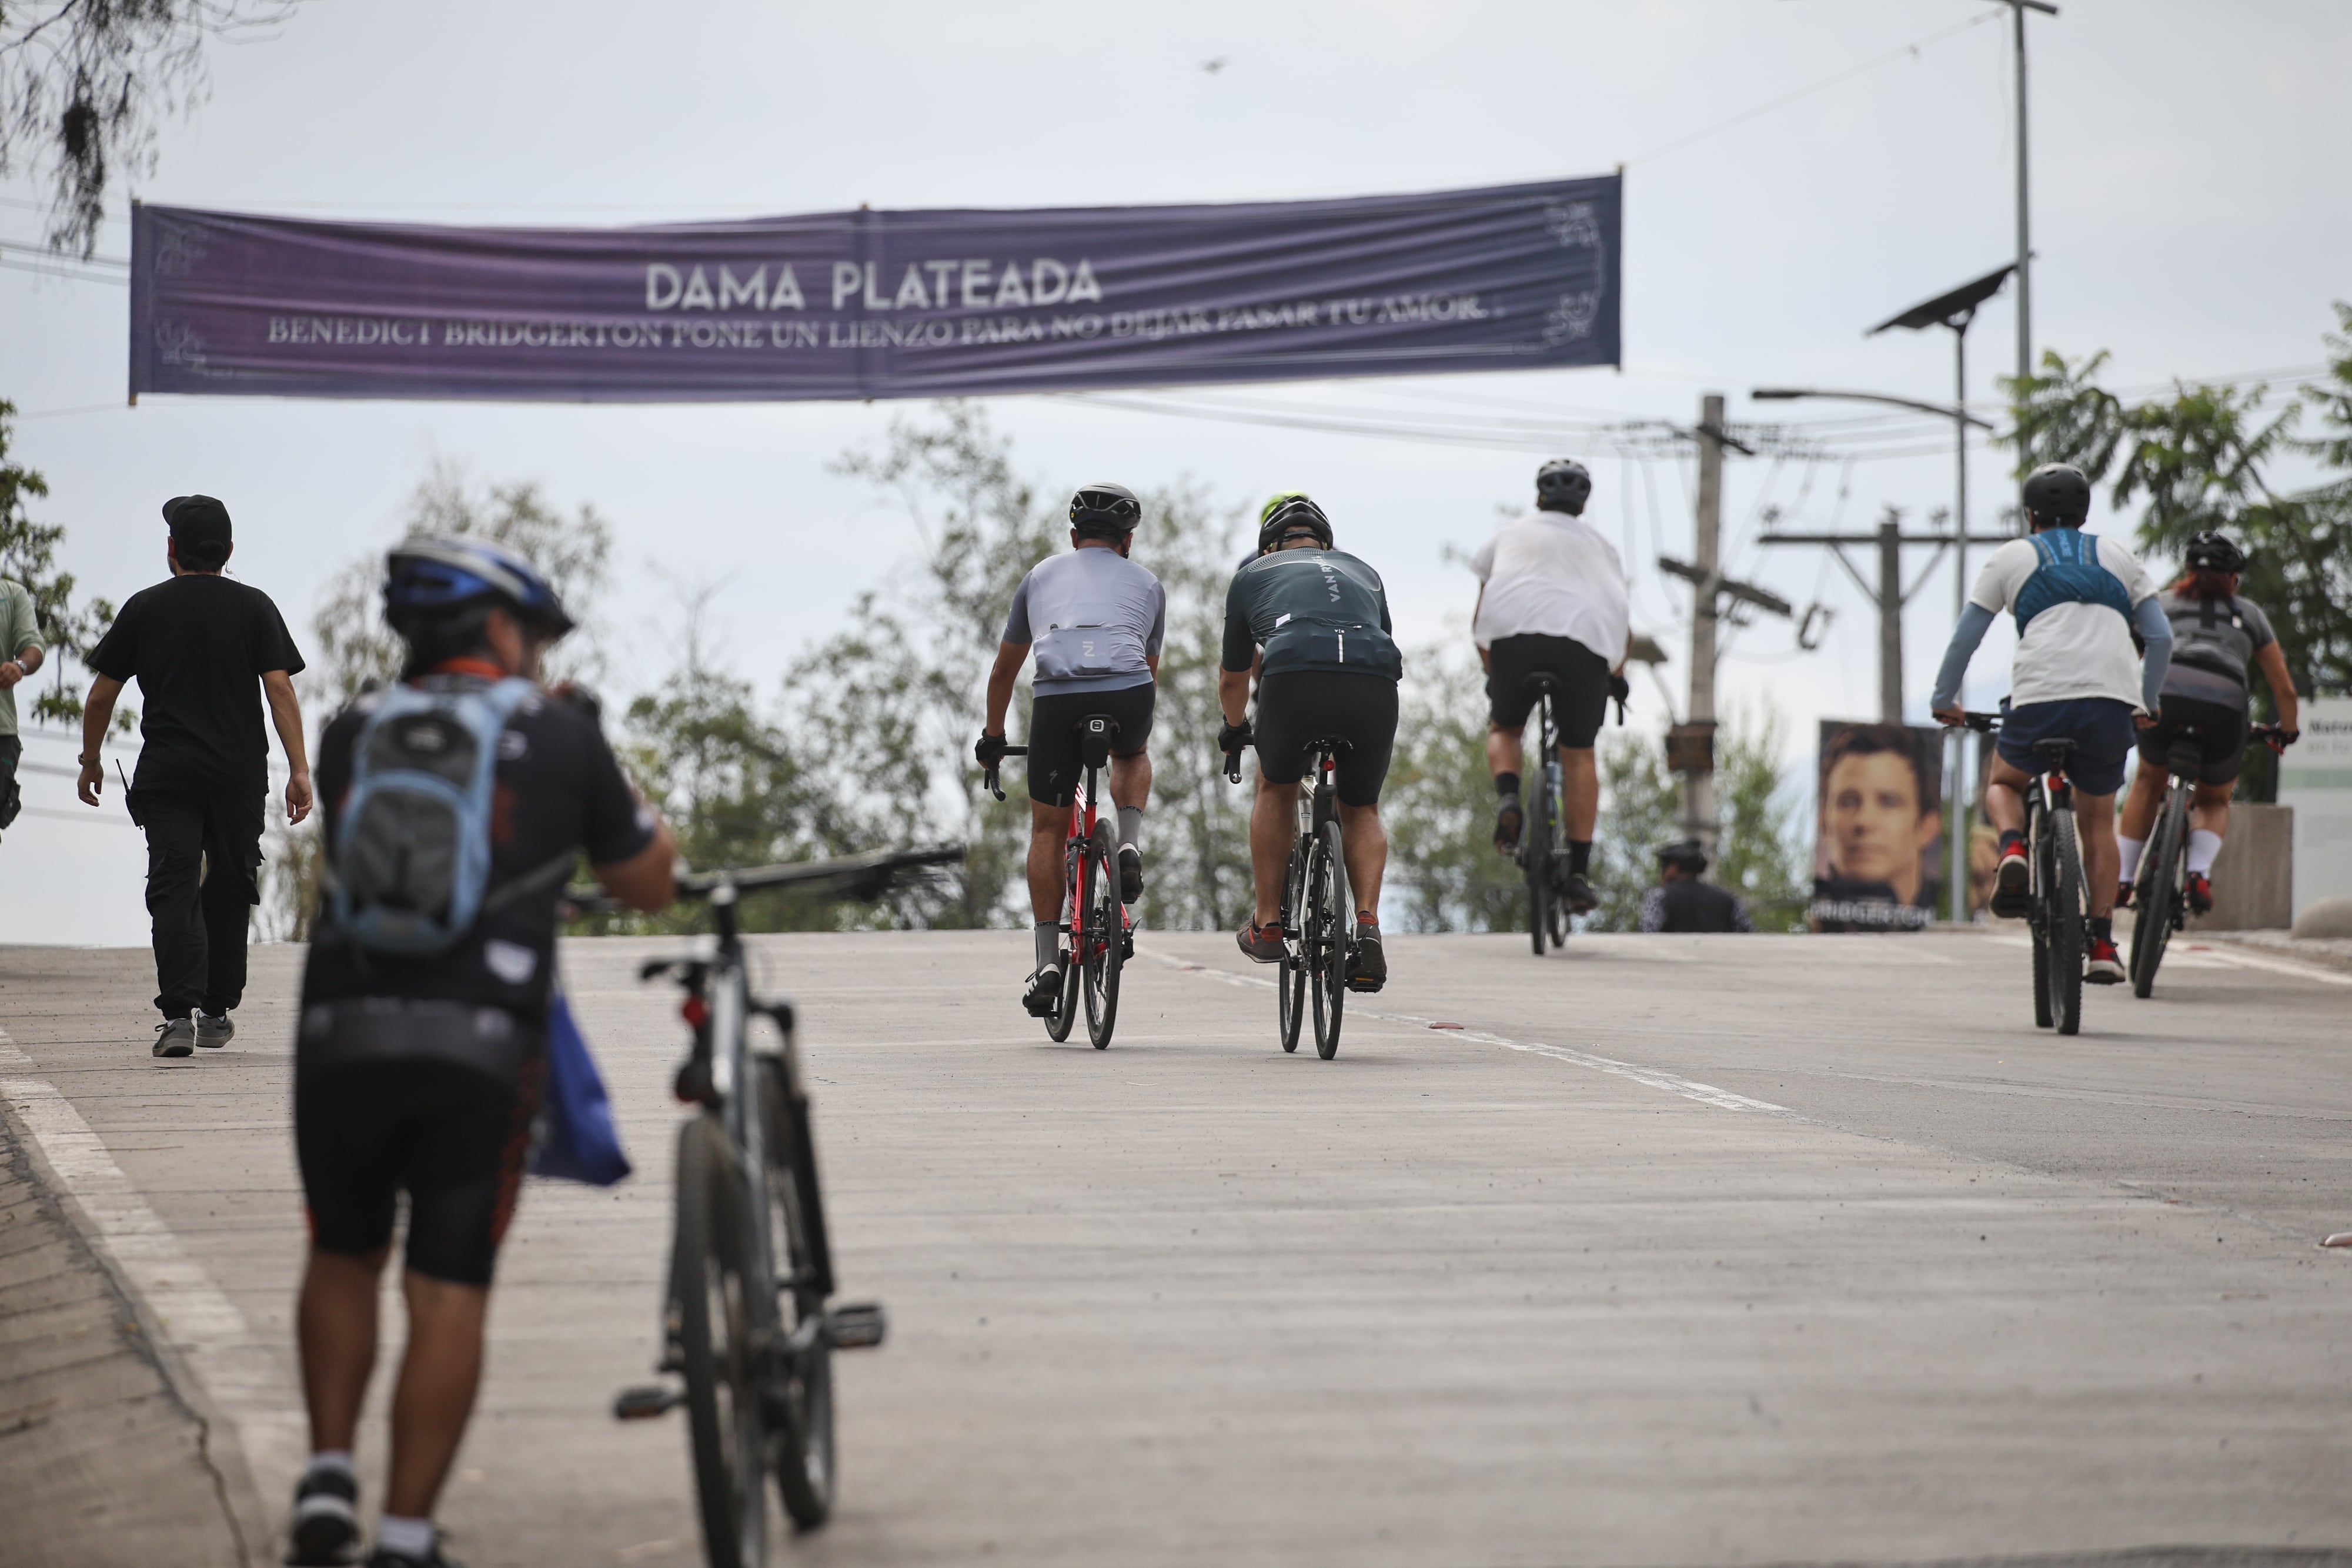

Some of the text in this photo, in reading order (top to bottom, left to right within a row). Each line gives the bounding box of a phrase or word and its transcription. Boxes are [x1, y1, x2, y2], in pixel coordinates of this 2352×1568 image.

[646, 257, 1103, 310] DAMA PLATEADA
[268, 316, 430, 346] BENEDICT
[445, 320, 663, 347] BRIDGERTON
[672, 320, 764, 348] PONE
[771, 320, 819, 348] UN
[828, 319, 954, 348] LIENZO
[961, 316, 1044, 345] PARA
[1051, 312, 1104, 340] NO
[1111, 307, 1210, 342] DEJAR
[1217, 301, 1318, 332] PASAR
[1322, 297, 1371, 325] TU
[1324, 575, 1341, 603] VAN
